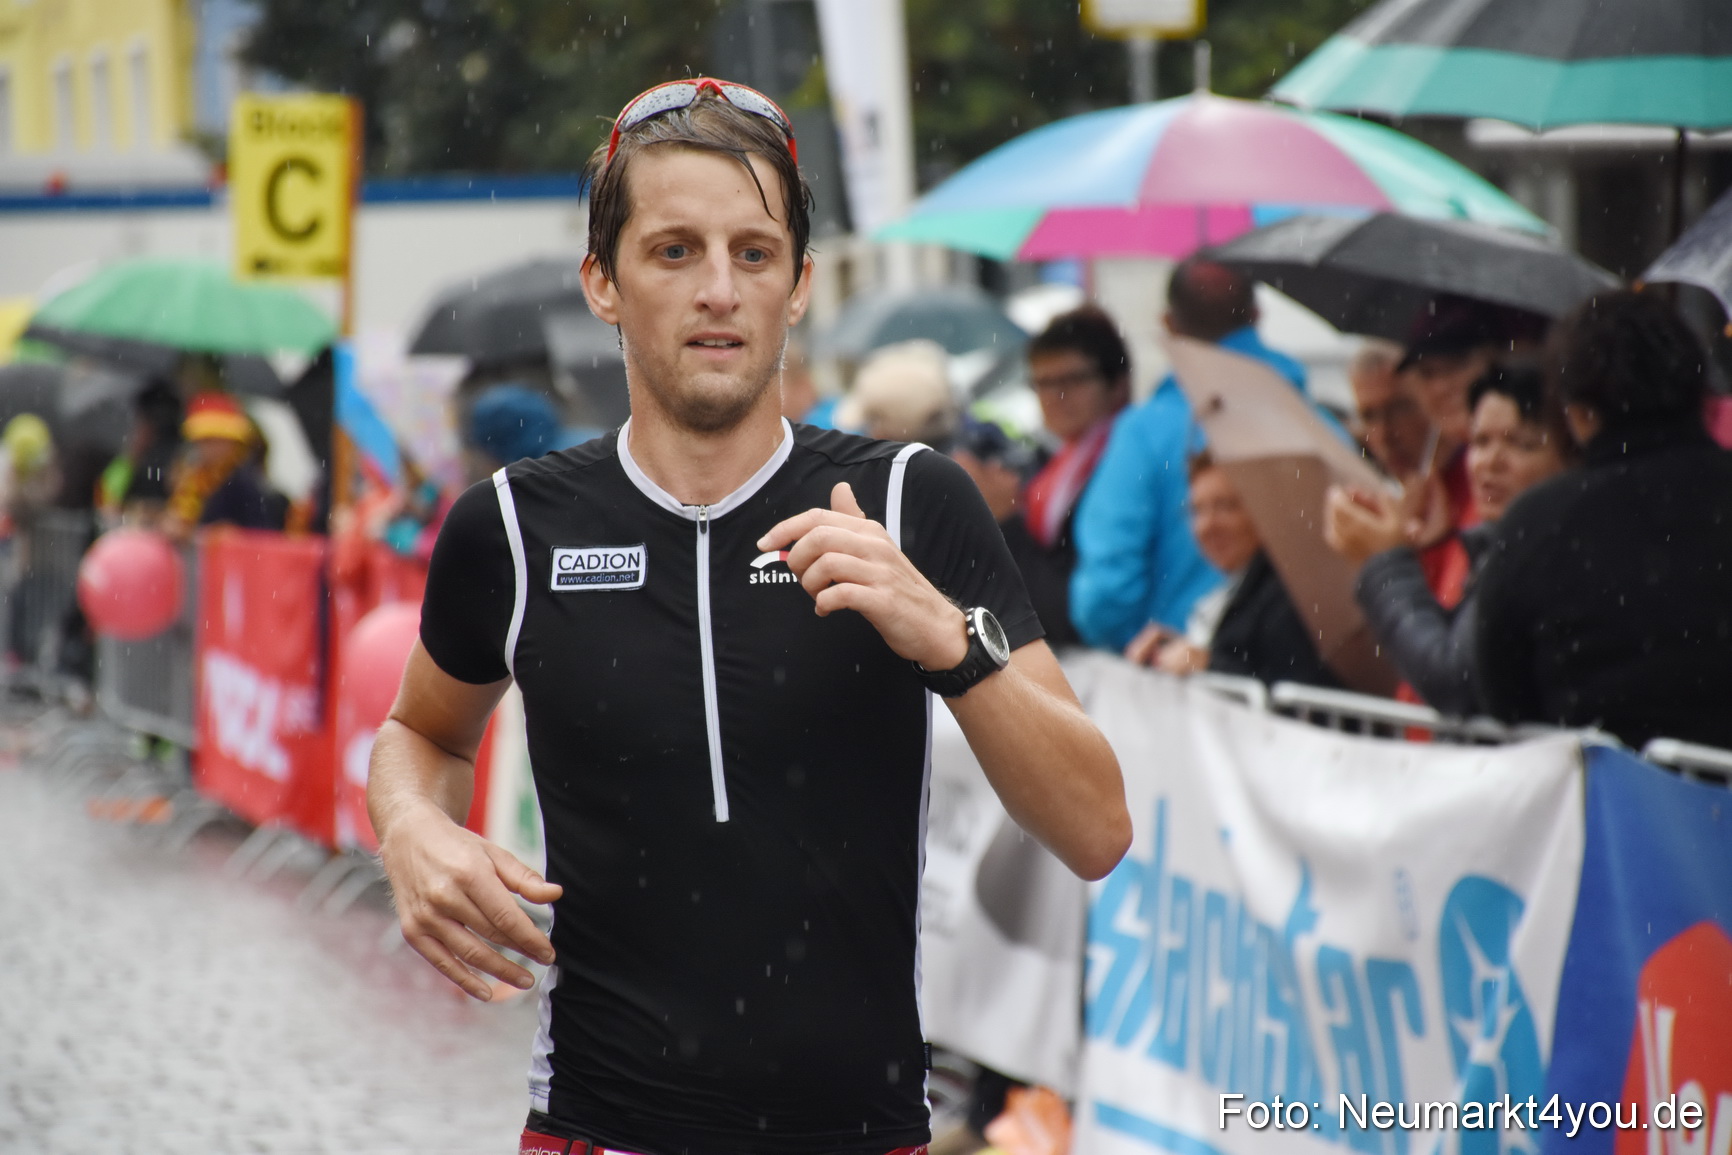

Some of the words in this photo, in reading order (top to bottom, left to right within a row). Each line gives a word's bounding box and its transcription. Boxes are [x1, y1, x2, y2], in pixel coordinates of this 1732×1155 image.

[263, 156, 322, 242] C
[558, 552, 640, 571] CADION
[560, 572, 635, 584] www.cadion.net
